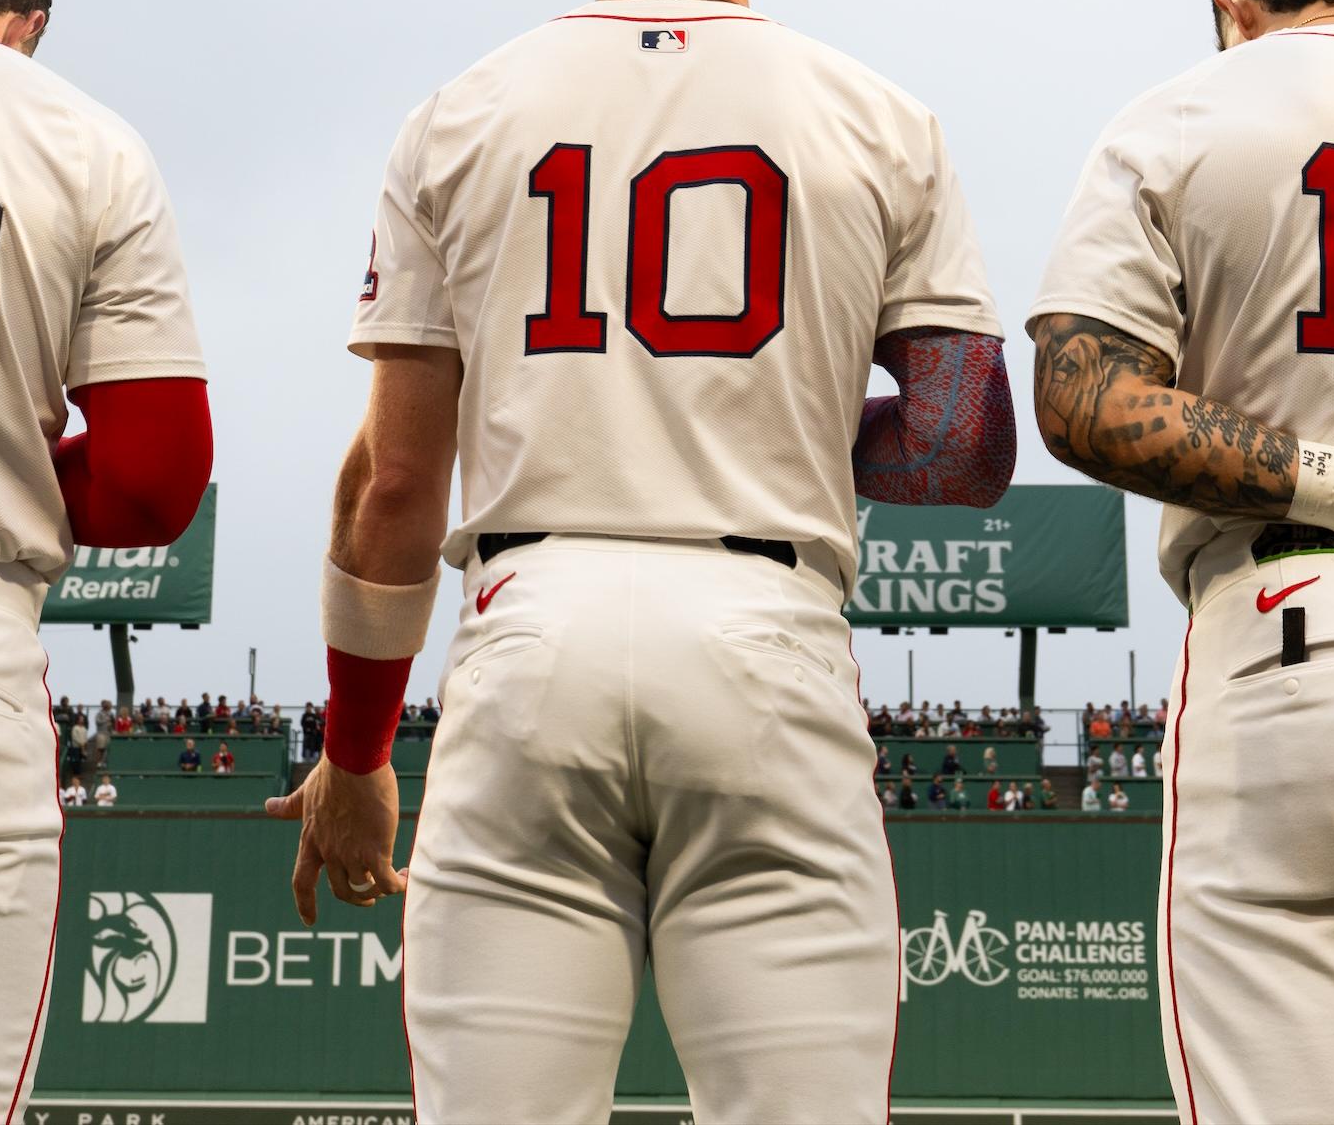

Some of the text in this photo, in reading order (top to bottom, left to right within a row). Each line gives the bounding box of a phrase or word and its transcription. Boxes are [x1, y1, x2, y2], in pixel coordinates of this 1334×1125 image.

[525, 142, 788, 358] 10
[983, 518, 1011, 532] 21+
[857, 540, 1012, 574] RAFT
[60, 575, 161, 599] Rental
[844, 575, 1007, 613] KINGS
[1015, 921, 1146, 942] PAN-MASS
[1016, 945, 1146, 964] CHALLENGE
[1017, 968, 1148, 984] GOAL: $76,000,000
[1017, 987, 1149, 1000] DONATE: PMC.ORG
[78, 1113, 166, 1125] PARK
